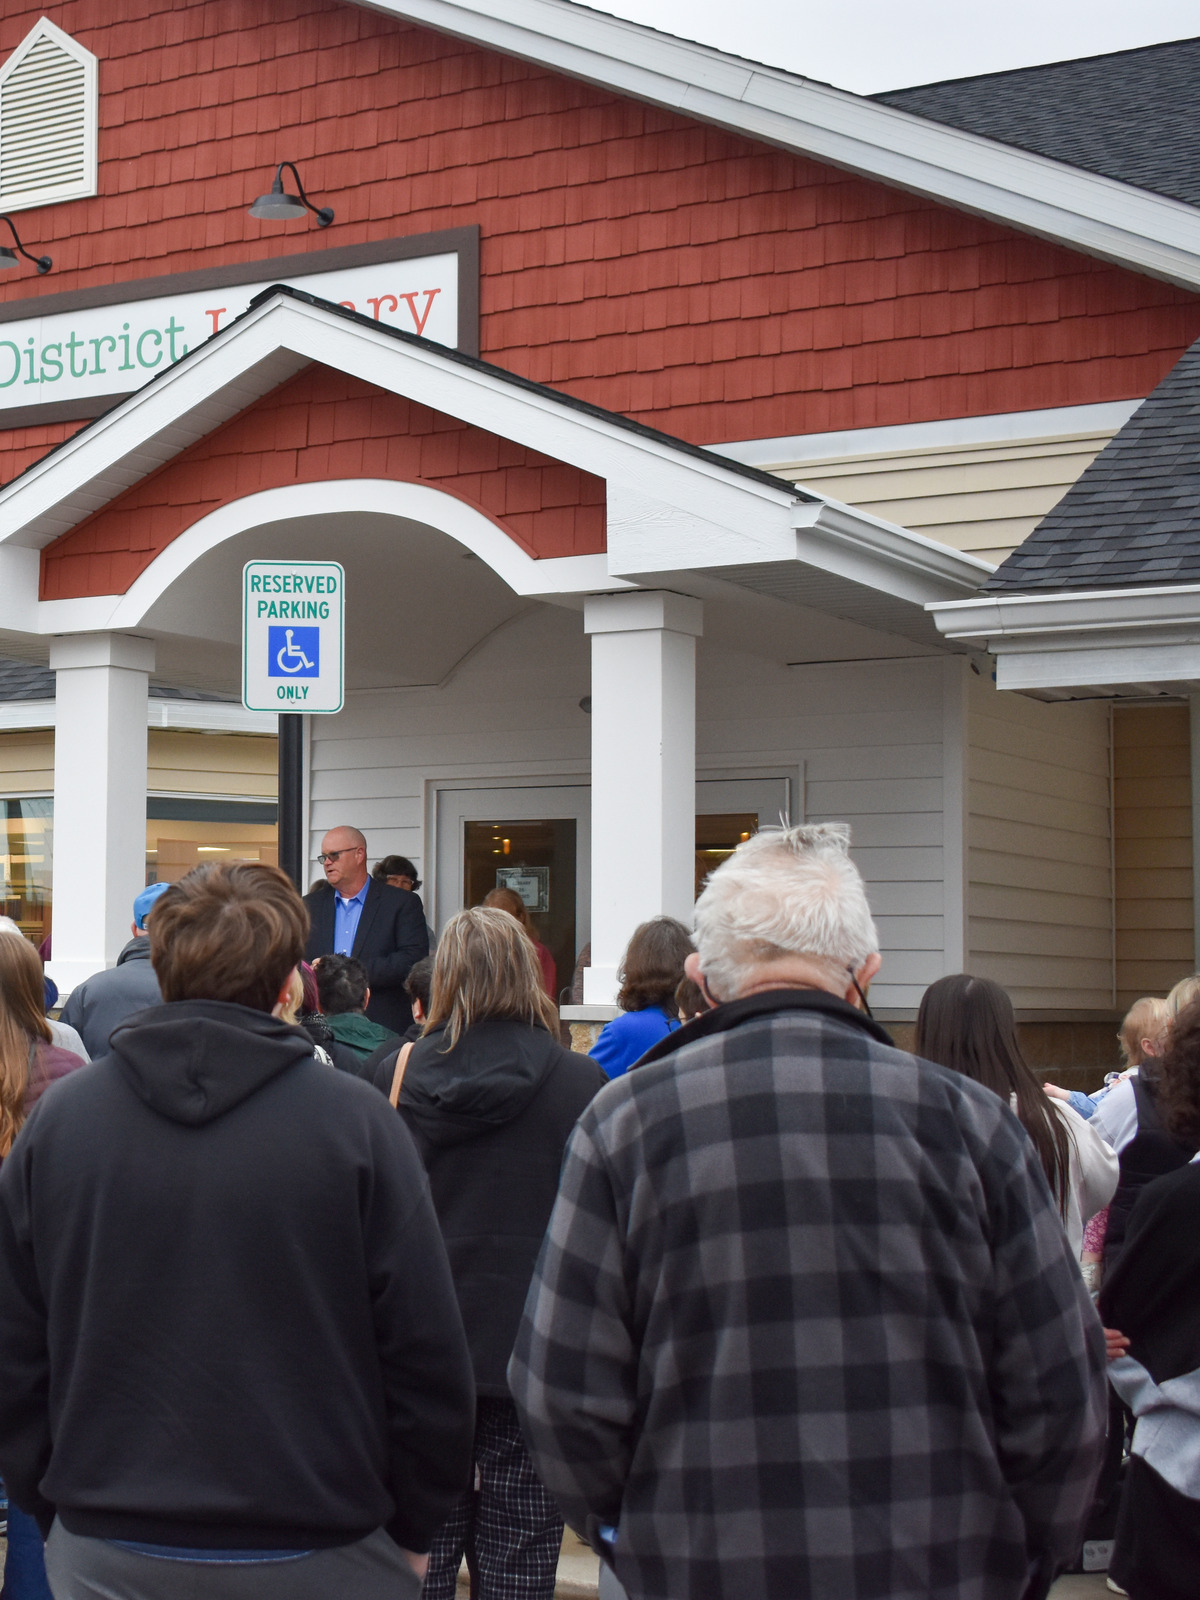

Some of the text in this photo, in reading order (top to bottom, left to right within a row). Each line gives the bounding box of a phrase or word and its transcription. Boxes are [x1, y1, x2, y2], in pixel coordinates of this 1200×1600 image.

[250, 574, 338, 594] RESERVED
[257, 600, 330, 620] PARKING
[276, 685, 310, 700] ONLY
